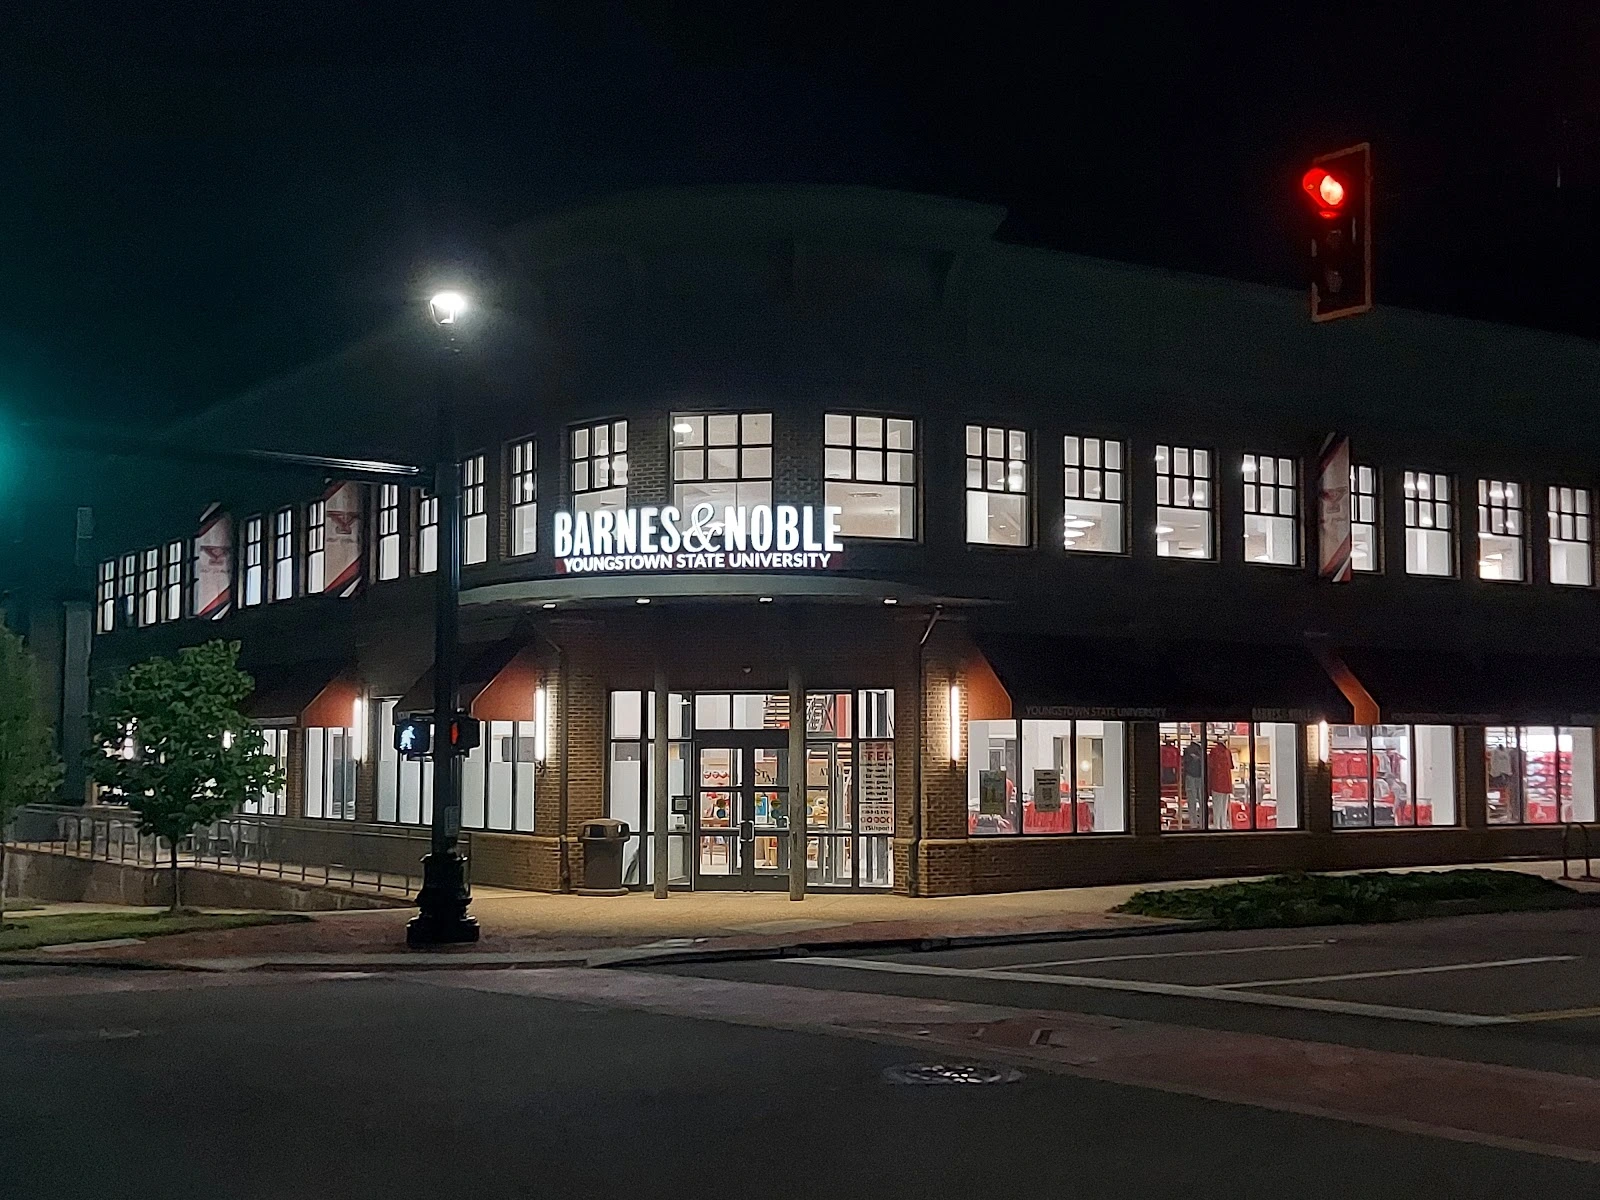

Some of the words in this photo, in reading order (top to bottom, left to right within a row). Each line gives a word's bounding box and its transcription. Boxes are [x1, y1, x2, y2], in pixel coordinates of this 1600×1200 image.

[554, 506, 681, 558] BARNES
[681, 503, 726, 553] &
[725, 505, 844, 553] NOBLE
[563, 554, 673, 572] YOUNGSTOWN
[676, 554, 724, 569] STATE
[728, 553, 831, 569] UNIVERSITY
[1025, 705, 1091, 716] YOUNGSTOWN
[1091, 706, 1117, 716] STATE
